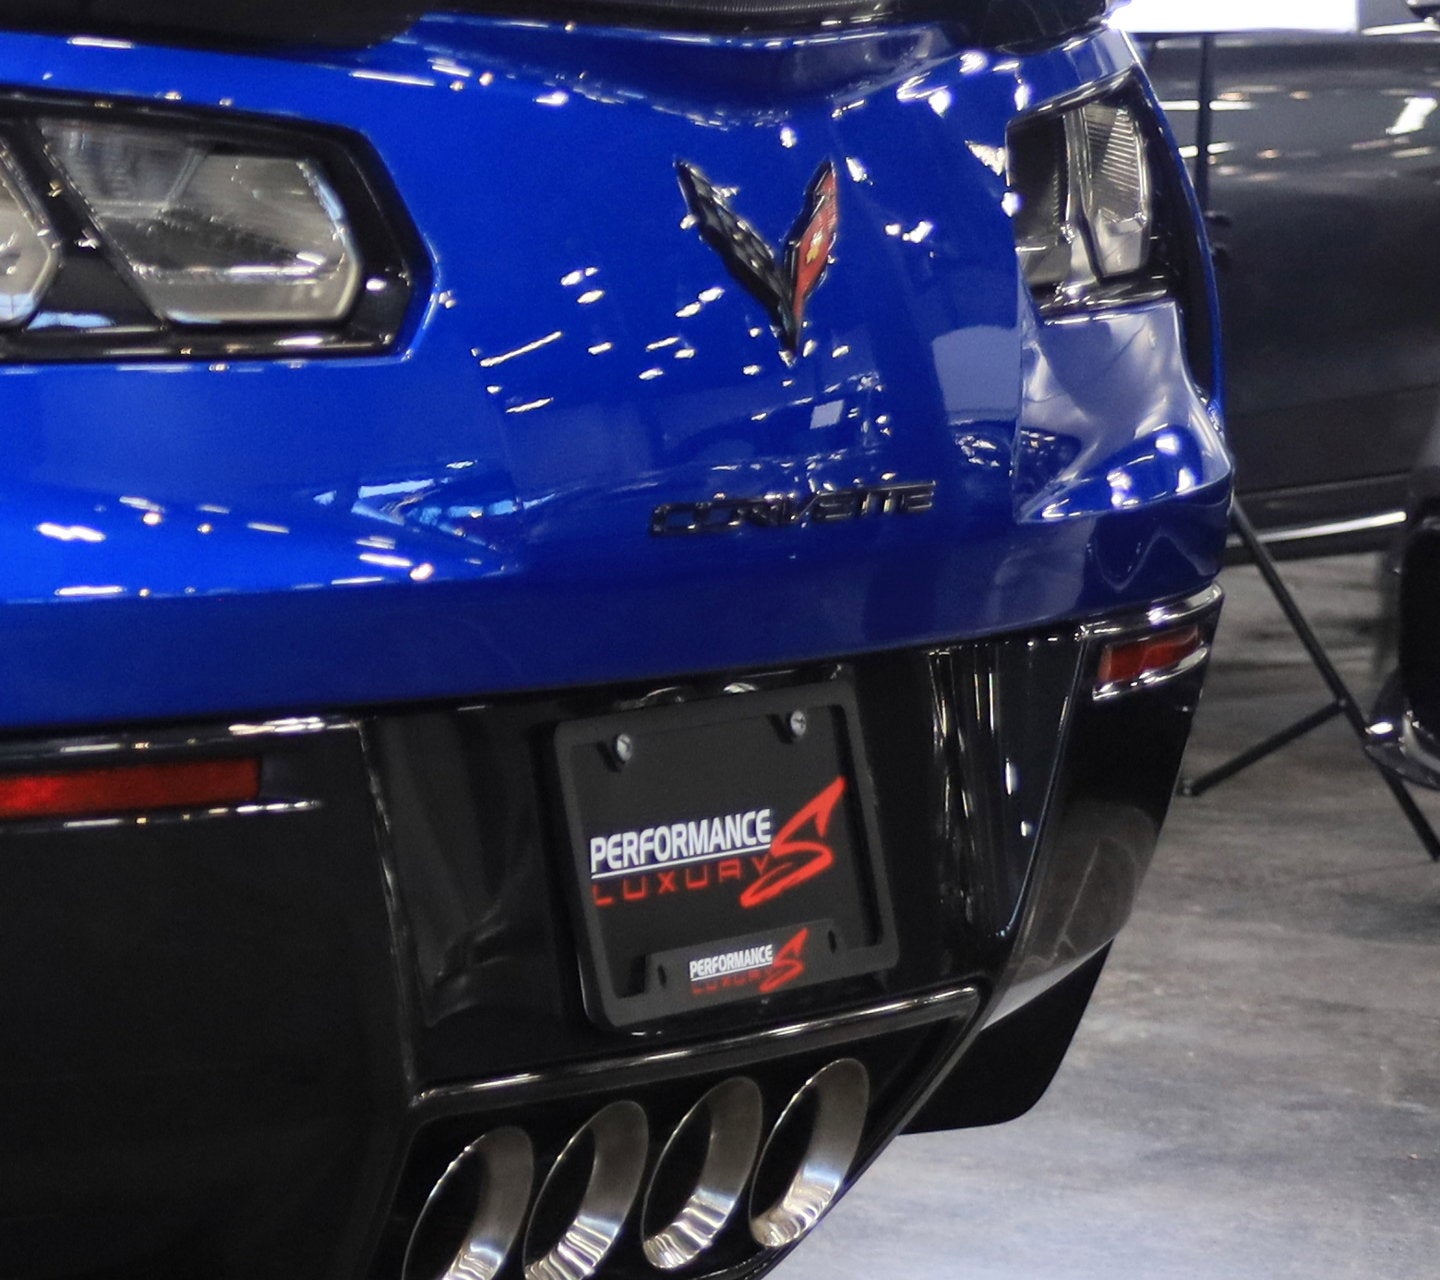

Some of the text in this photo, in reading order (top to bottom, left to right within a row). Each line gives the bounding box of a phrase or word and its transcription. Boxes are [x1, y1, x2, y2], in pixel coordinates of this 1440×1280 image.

[590, 808, 772, 874] PERFORMANCE
[591, 856, 769, 906] LUXURY
[689, 943, 774, 980] PERFORMANCE
